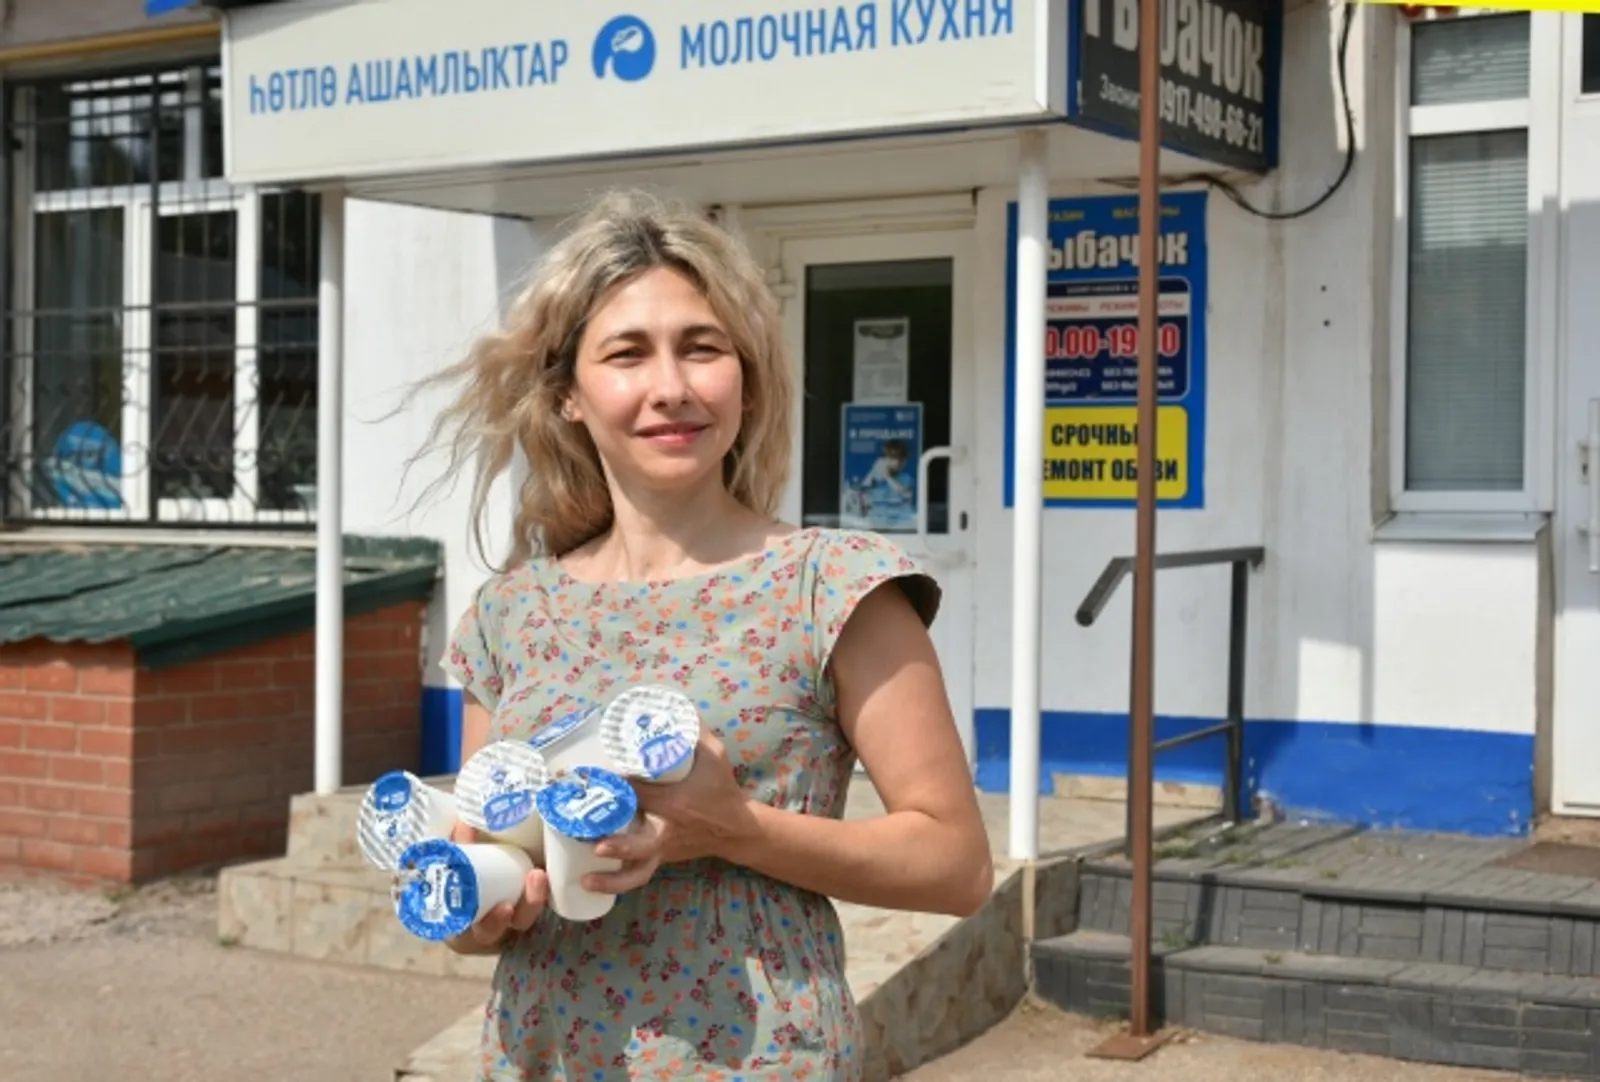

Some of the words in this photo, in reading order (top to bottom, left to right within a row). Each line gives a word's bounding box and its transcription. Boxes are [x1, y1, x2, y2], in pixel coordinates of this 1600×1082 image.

[680, 2, 877, 69] МОЛОЧНАЯ
[890, 0, 1014, 46] КУХНЯ
[1046, 230, 1188, 271] ыбачк
[1051, 424, 1139, 446] СРОЧНЫ
[1043, 459, 1106, 481] ЕМОНТ
[1111, 459, 1178, 481] ОБВИ
